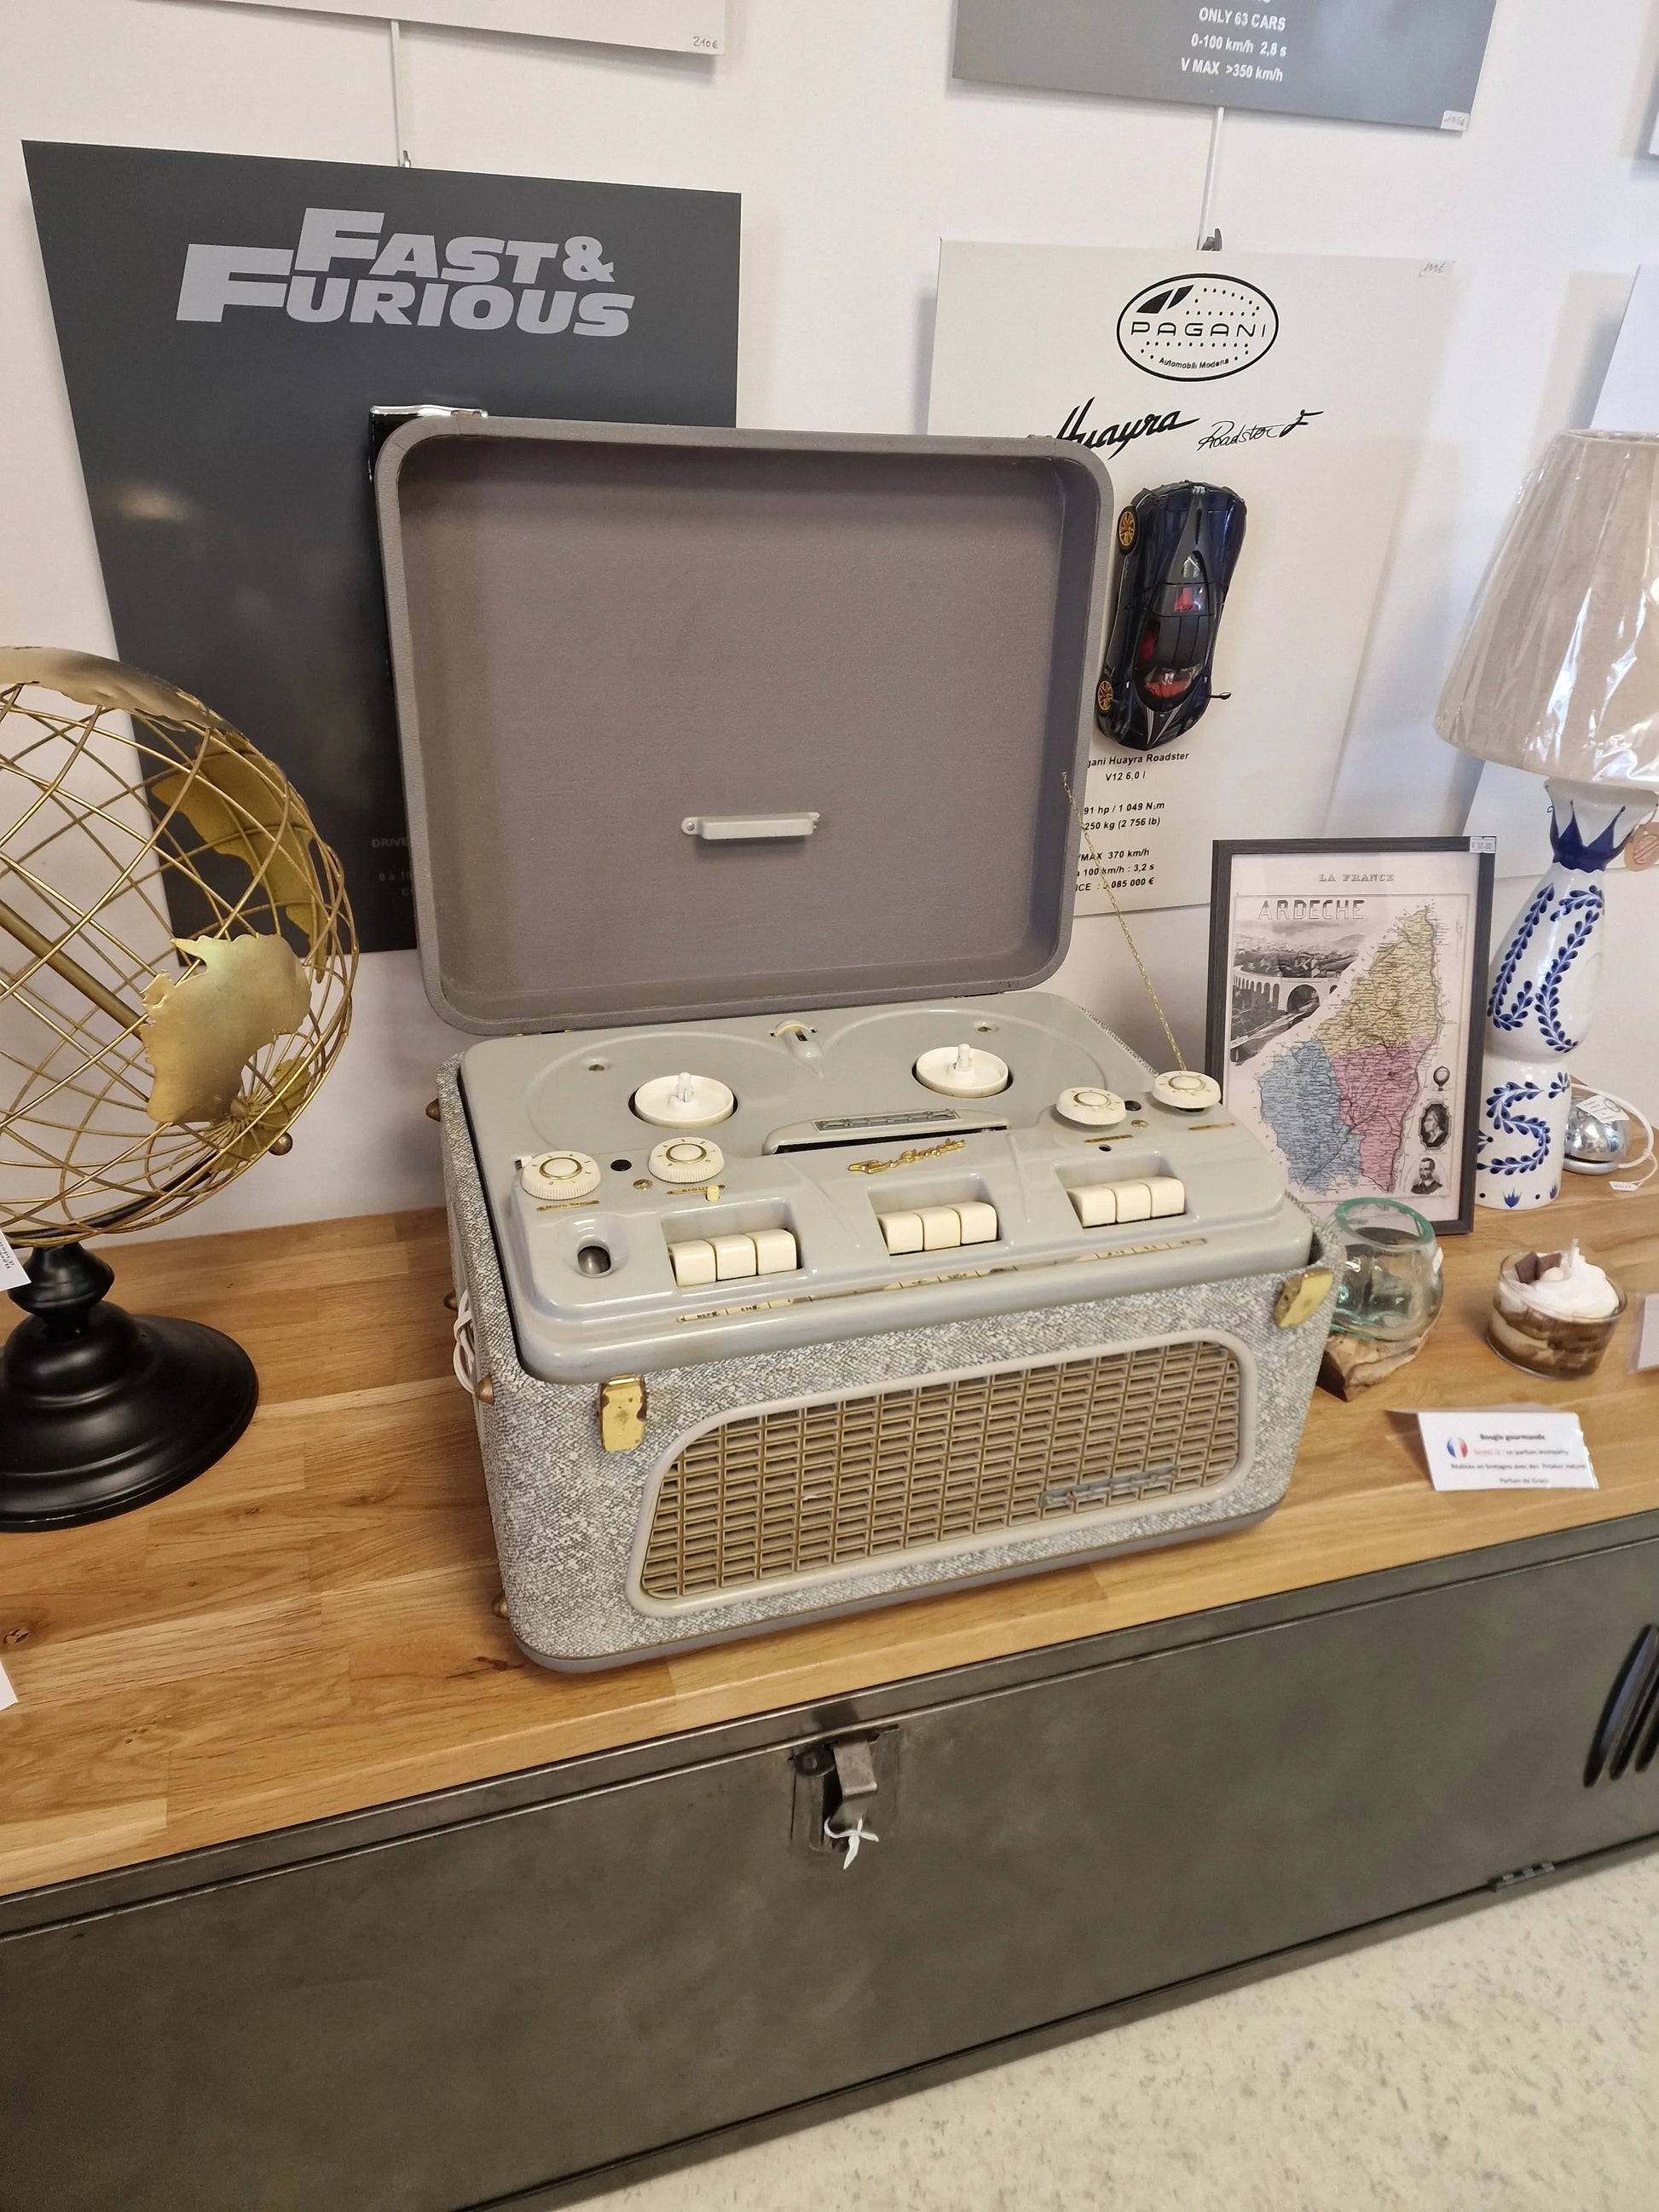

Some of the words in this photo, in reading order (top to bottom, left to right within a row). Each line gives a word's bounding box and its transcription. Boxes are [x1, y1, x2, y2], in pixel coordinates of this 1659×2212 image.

[1199, 7, 1233, 24] ONLY
[1234, 11, 1249, 27] 63
[1251, 13, 1286, 32] CARS
[1191, 32, 1223, 50] 0-100
[1226, 37, 1254, 54] km/h
[1259, 40, 1278, 57] 2,8
[1280, 46, 1287, 57] s
[1181, 57, 1190, 72] V
[1192, 59, 1220, 75] MAX
[1225, 64, 1253, 78] >350
[1256, 66, 1283, 82] km/h
[176, 244, 635, 337] FURIOUS
[1130, 321, 1266, 338] PAGANI
[1199, 357, 1229, 369] Modena
[1109, 755, 1143, 766] Huayra
[1147, 752, 1189, 763] Roadster
[1106, 772, 1123, 782] V12
[1125, 771, 1140, 782] 6,0
[1097, 805, 1110, 816] hp
[1126, 802, 1143, 811] 049
[1103, 821, 1115, 831] kg
[1118, 819, 1127, 830] (2
[1130, 817, 1146, 827] 756
[1107, 851, 1124, 860] 370
[1127, 848, 1150, 858] km/h
[1084, 868, 1100, 877] 100
[1101, 865, 1124, 875] km/h
[1134, 863, 1147, 874] 3,2
[1111, 879, 1127, 888] 085
[1130, 878, 1146, 887] 000
[1148, 876, 1154, 885] €
[1257, 899, 1365, 920] ARDECHE
